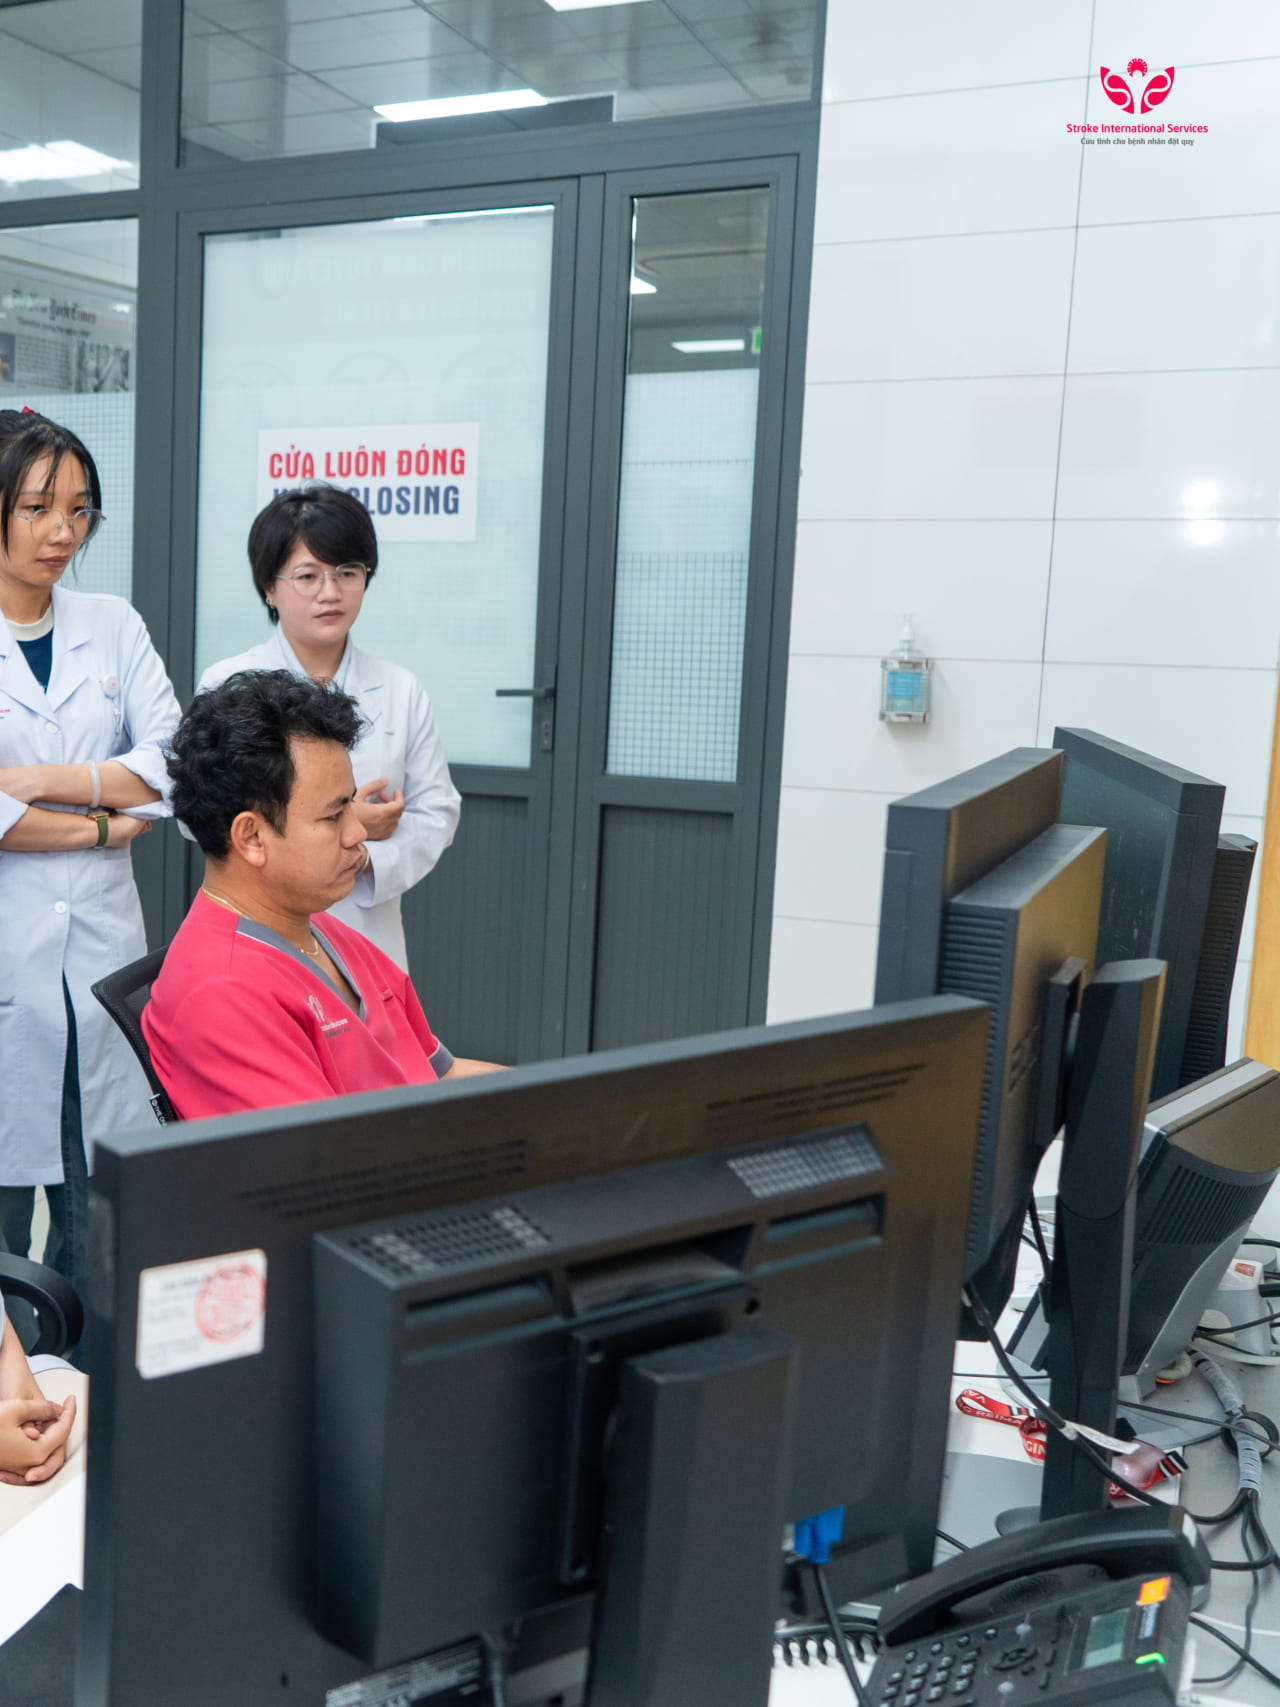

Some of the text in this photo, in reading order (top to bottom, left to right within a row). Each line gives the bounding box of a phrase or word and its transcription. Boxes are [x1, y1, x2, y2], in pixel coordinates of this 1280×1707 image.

[269, 443, 466, 479] CỬA LUÔN ĐÓNG
